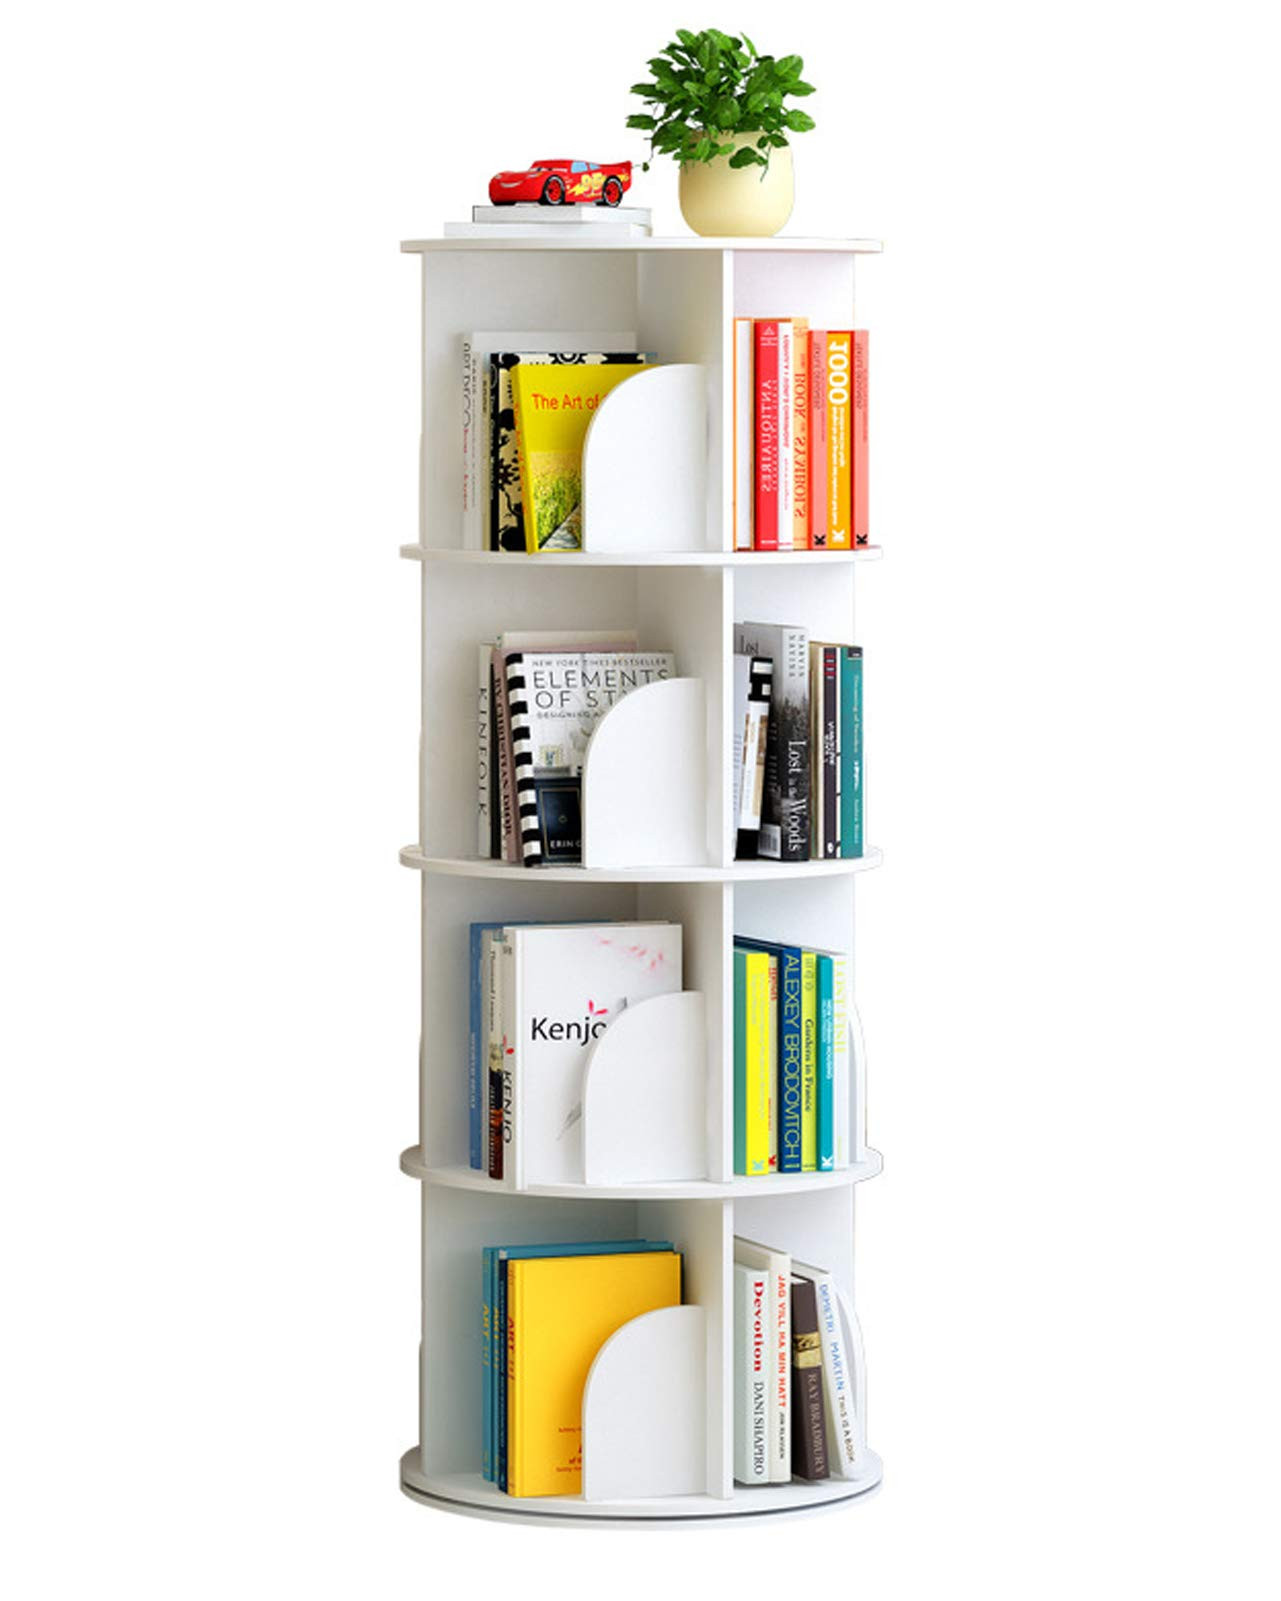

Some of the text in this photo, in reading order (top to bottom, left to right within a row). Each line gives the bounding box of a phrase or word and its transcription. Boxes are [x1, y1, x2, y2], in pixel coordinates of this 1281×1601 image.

[531, 393, 600, 410] The Art of
[533, 669, 669, 689] ELEMENTS
[613, 658, 667, 667] BESTSELLER
[535, 690, 572, 709] OF
[788, 740, 806, 774] Lost
[502, 795, 513, 836] DIOR
[550, 840, 574, 849] ERIN
[788, 798, 807, 852] Woods
[784, 954, 799, 1031] ALEXEY
[531, 1017, 607, 1046] Kenjo
[805, 1019, 813, 1111] Gardens in France
[784, 1034, 799, 1158] BRODOVITCH
[753, 1281, 765, 1372] Devotion
[778, 1274, 786, 1408] JAG VILL HA MIN HATT
[820, 1283, 845, 1392] DEMETRI MARTIN
[753, 1382, 764, 1476] DANI SHAPIRO
[807, 1373, 825, 1475] RAY BRADBURY
[837, 1395, 855, 1464] THIS IS A BOOK
